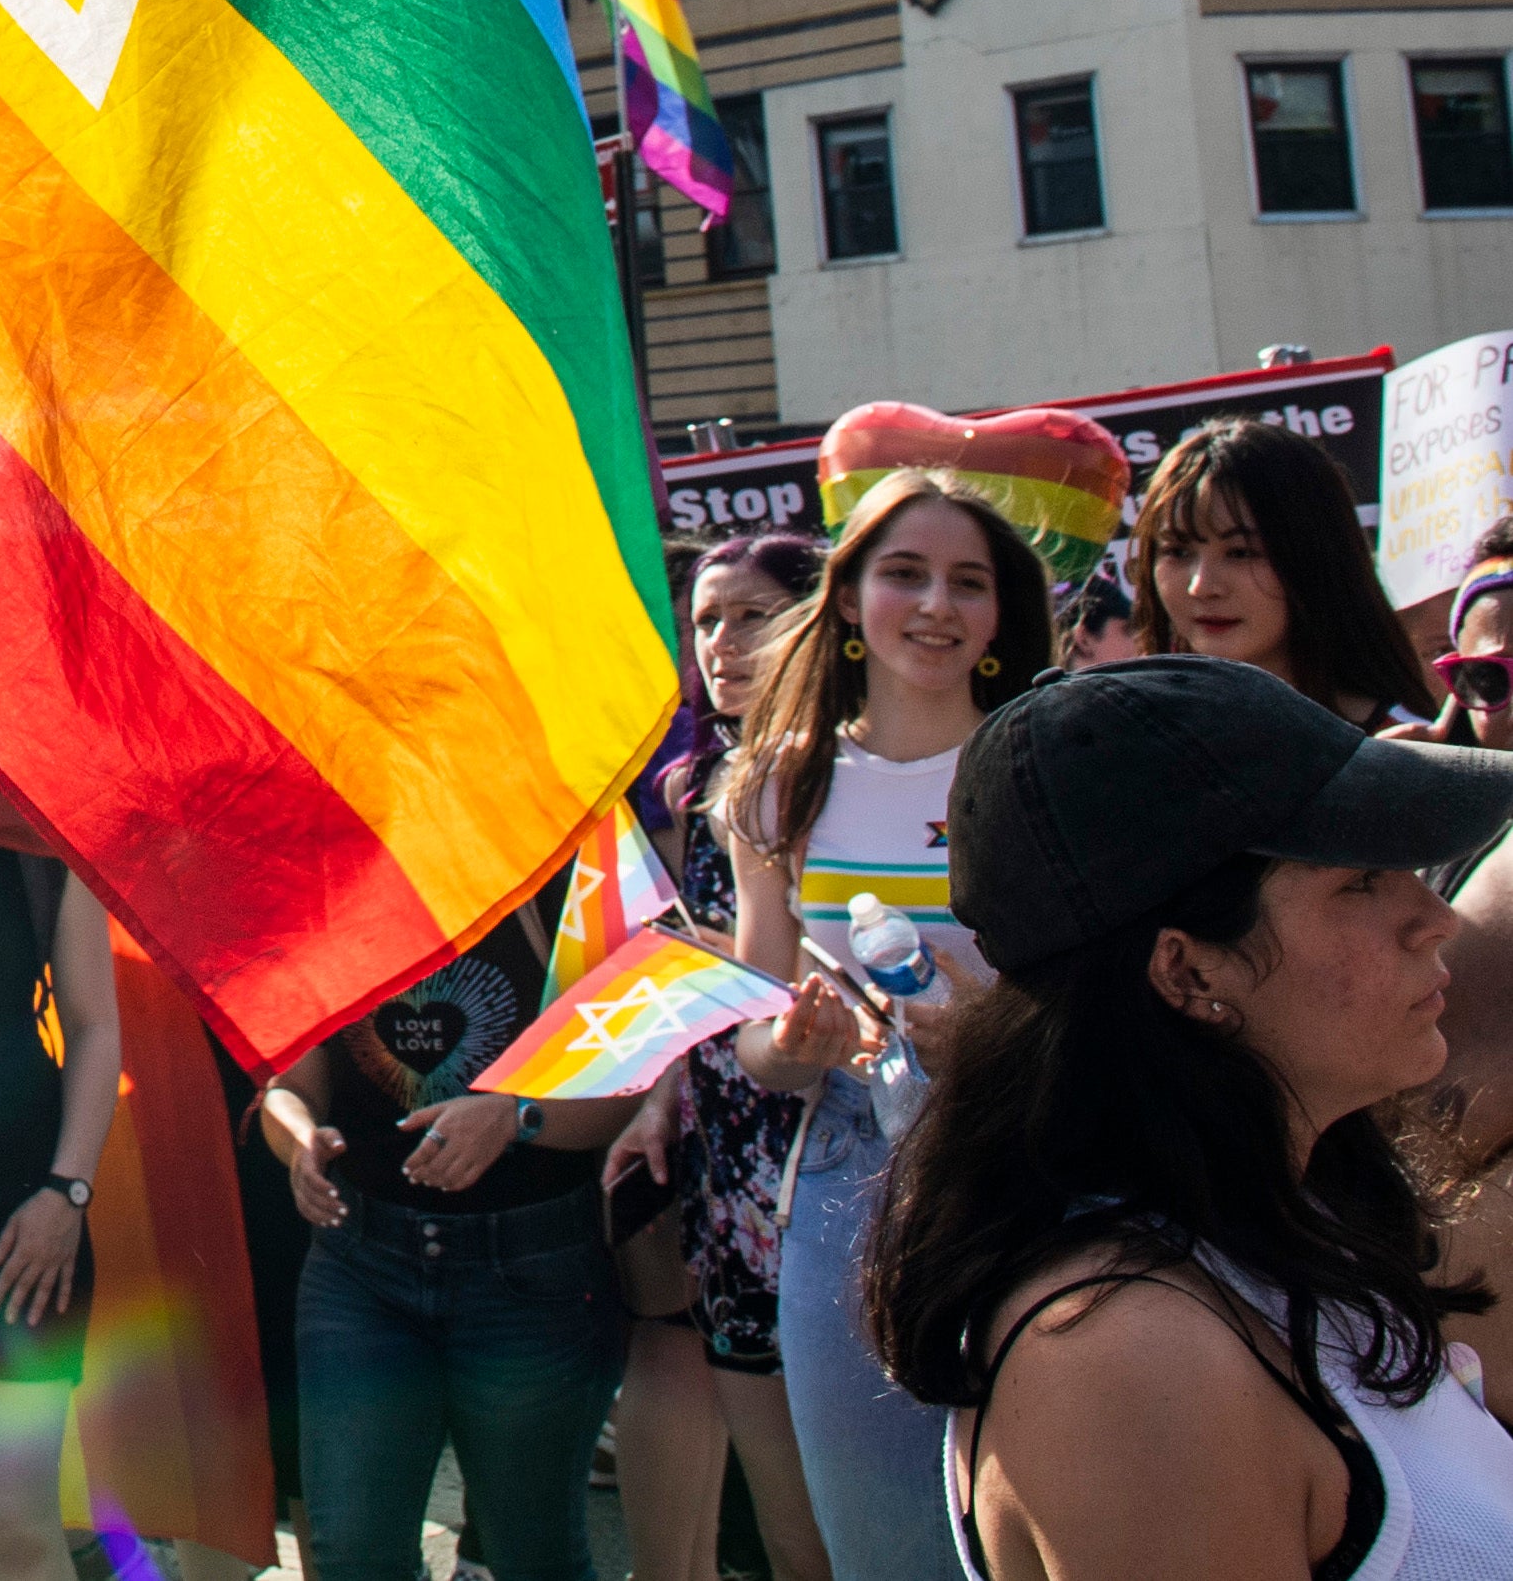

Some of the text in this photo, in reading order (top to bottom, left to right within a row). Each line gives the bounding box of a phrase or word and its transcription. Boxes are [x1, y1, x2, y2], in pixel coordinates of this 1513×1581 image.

[669, 482, 804, 528] Stop
[394, 1018, 443, 1032] LOVE
[395, 1038, 445, 1051] LOVE
